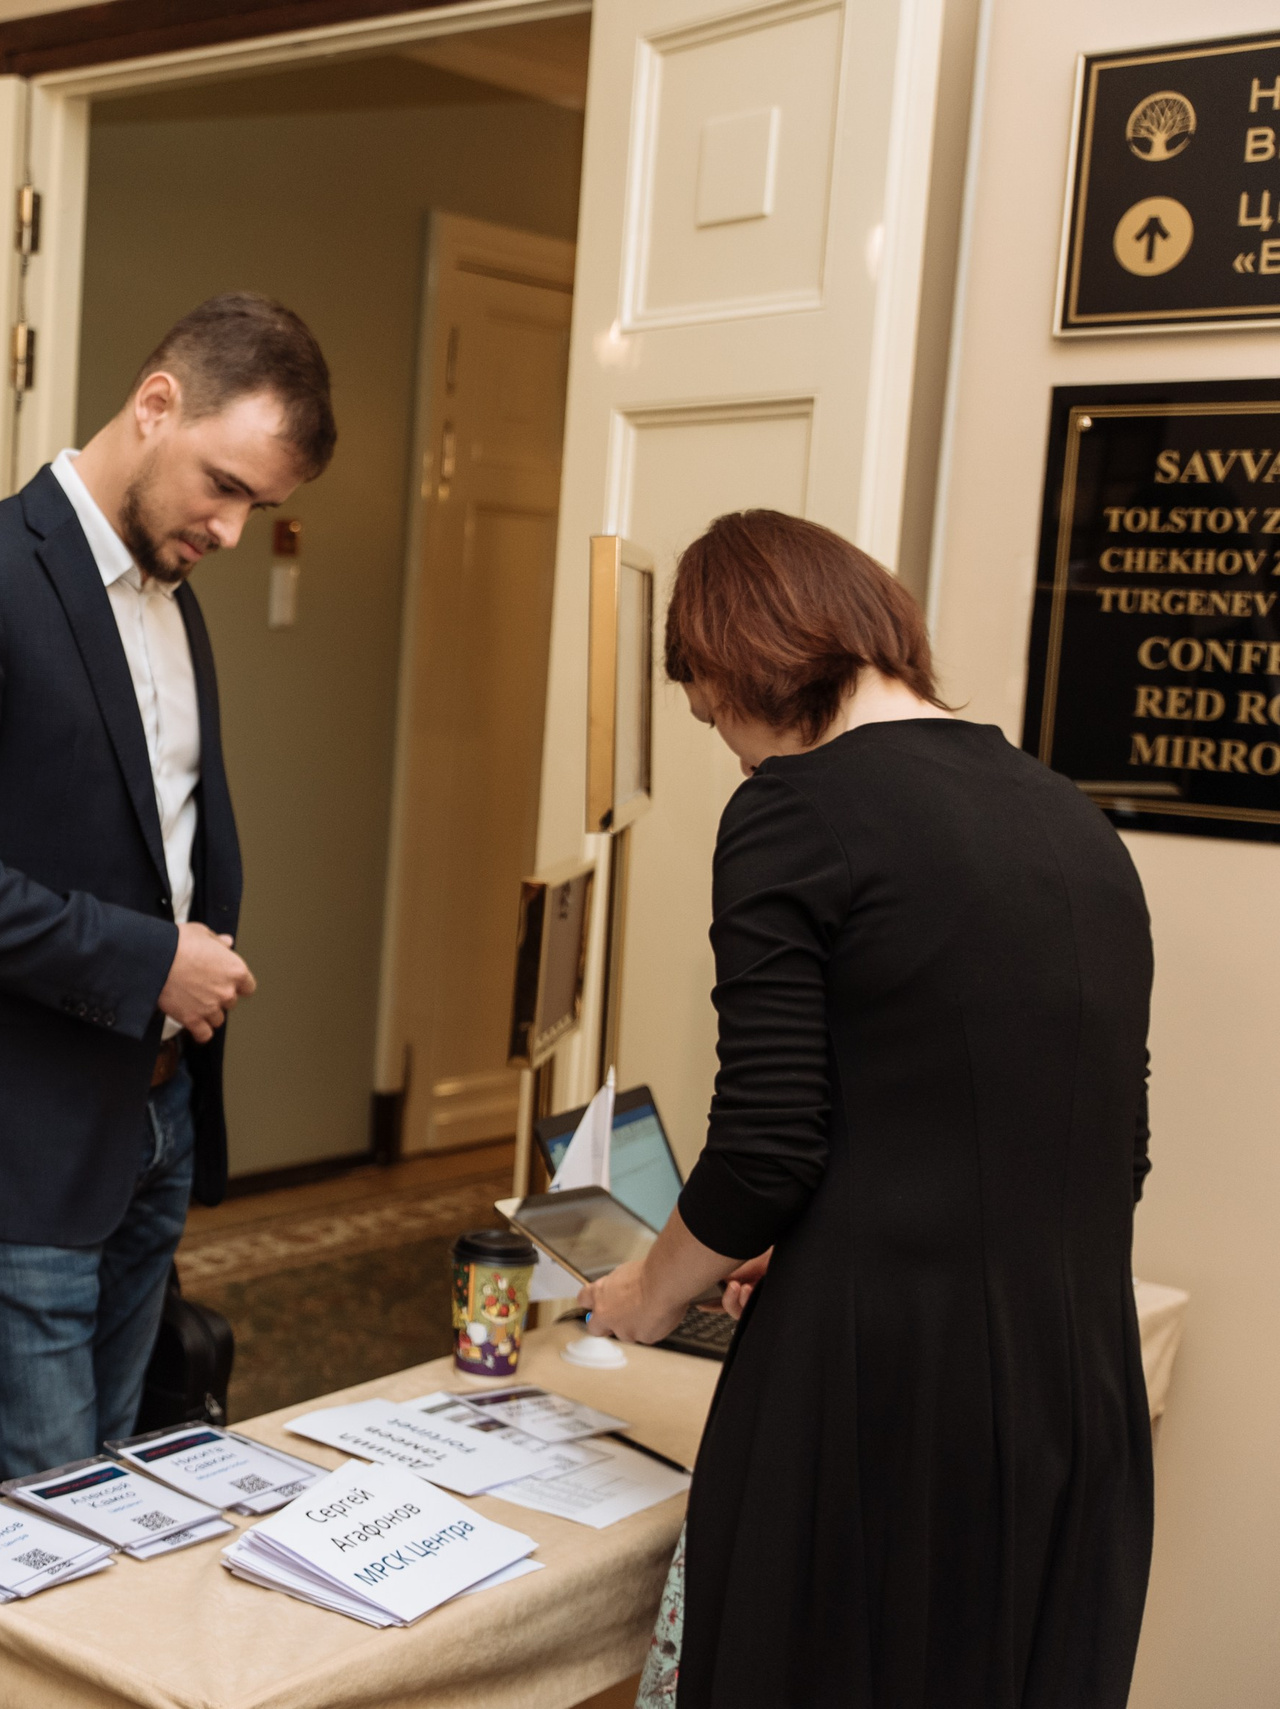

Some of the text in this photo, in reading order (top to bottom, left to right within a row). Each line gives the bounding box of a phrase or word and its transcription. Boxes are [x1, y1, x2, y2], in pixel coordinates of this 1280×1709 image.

[1103, 507, 1258, 534] TOLSTOY
[1099, 547, 1268, 575] CHEKHOV
[1096, 588, 1277, 618] TURGENEV
[1134, 685, 1227, 722] RED
[1129, 733, 1280, 777] MIRRO
[305, 1486, 375, 1524] Сергей
[330, 1502, 422, 1553] Агафонов
[353, 1518, 476, 1586] МРСК Центра
